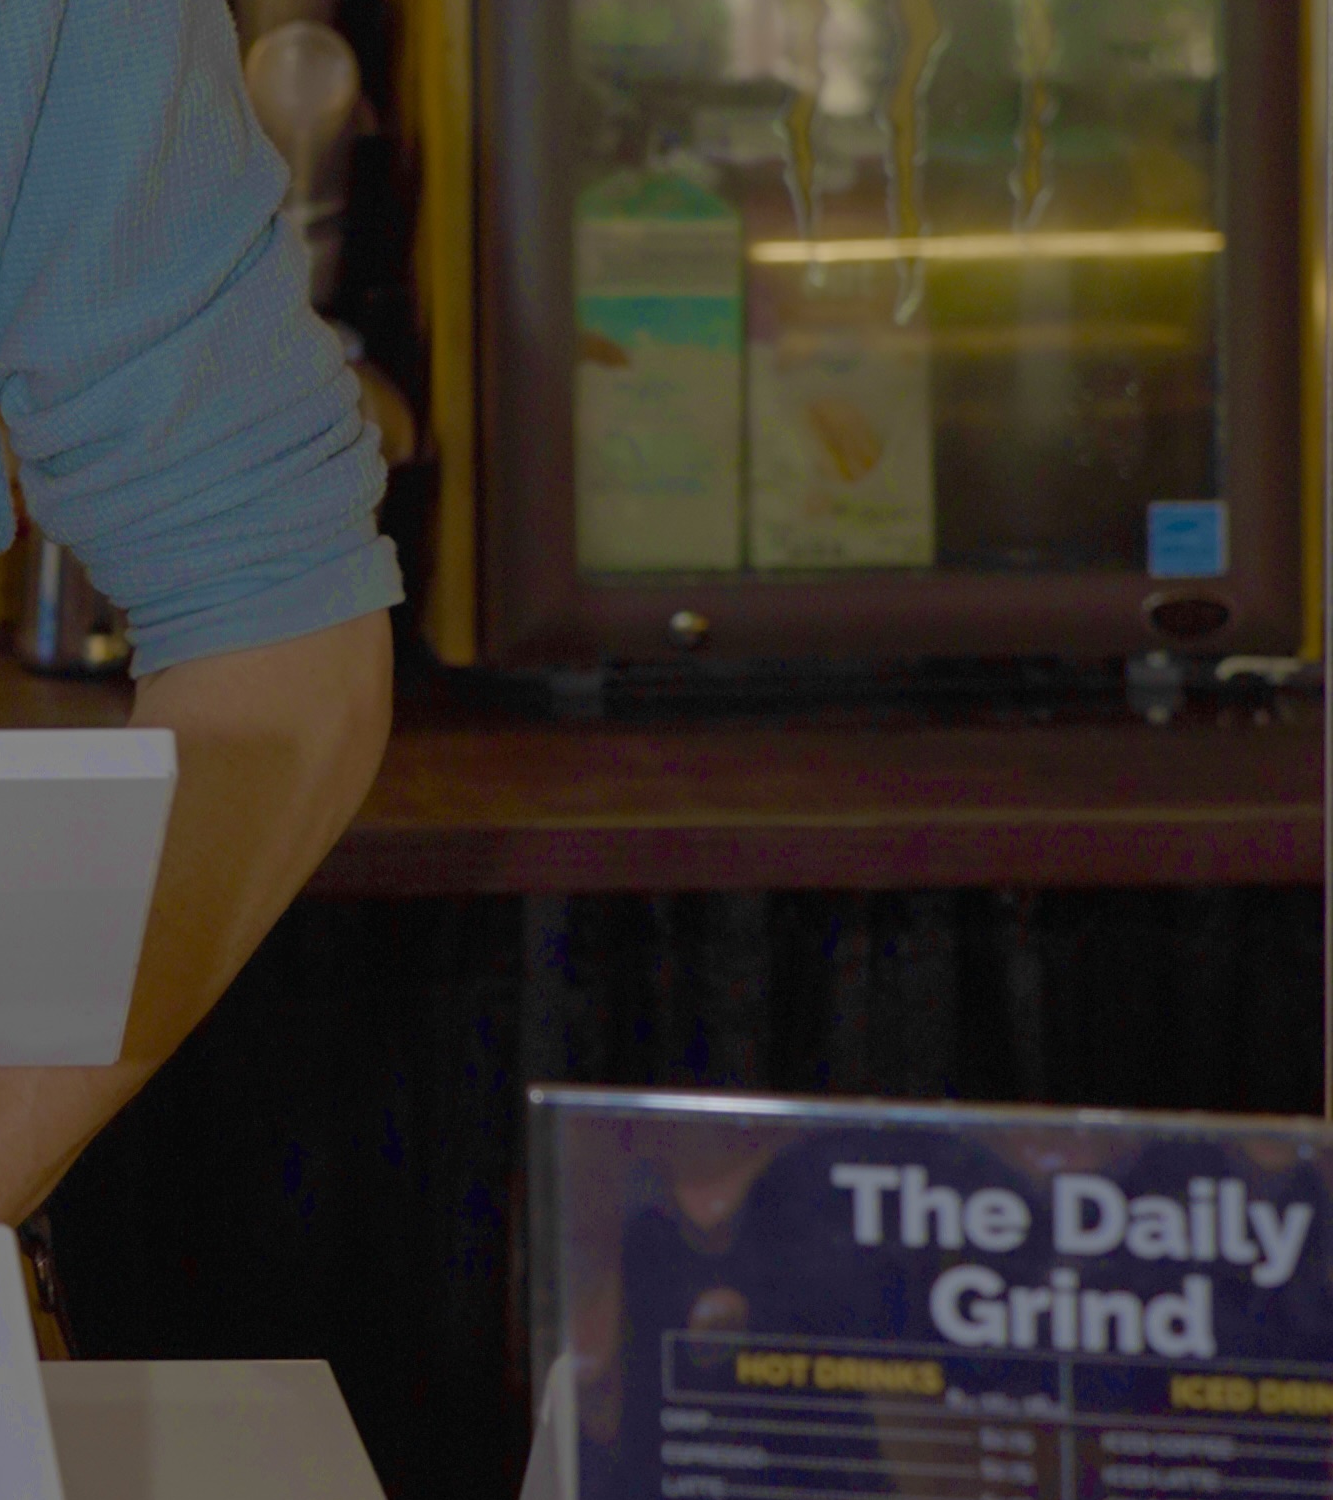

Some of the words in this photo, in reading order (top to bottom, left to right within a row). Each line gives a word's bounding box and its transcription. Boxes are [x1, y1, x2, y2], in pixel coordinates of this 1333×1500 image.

[830, 1163, 1032, 1253] The
[1051, 1173, 1314, 1289] Daily
[930, 1265, 1218, 1360] Grind
[735, 1351, 810, 1388] HOT
[813, 1353, 946, 1395] DRINKS
[1170, 1374, 1255, 1413] ICED
